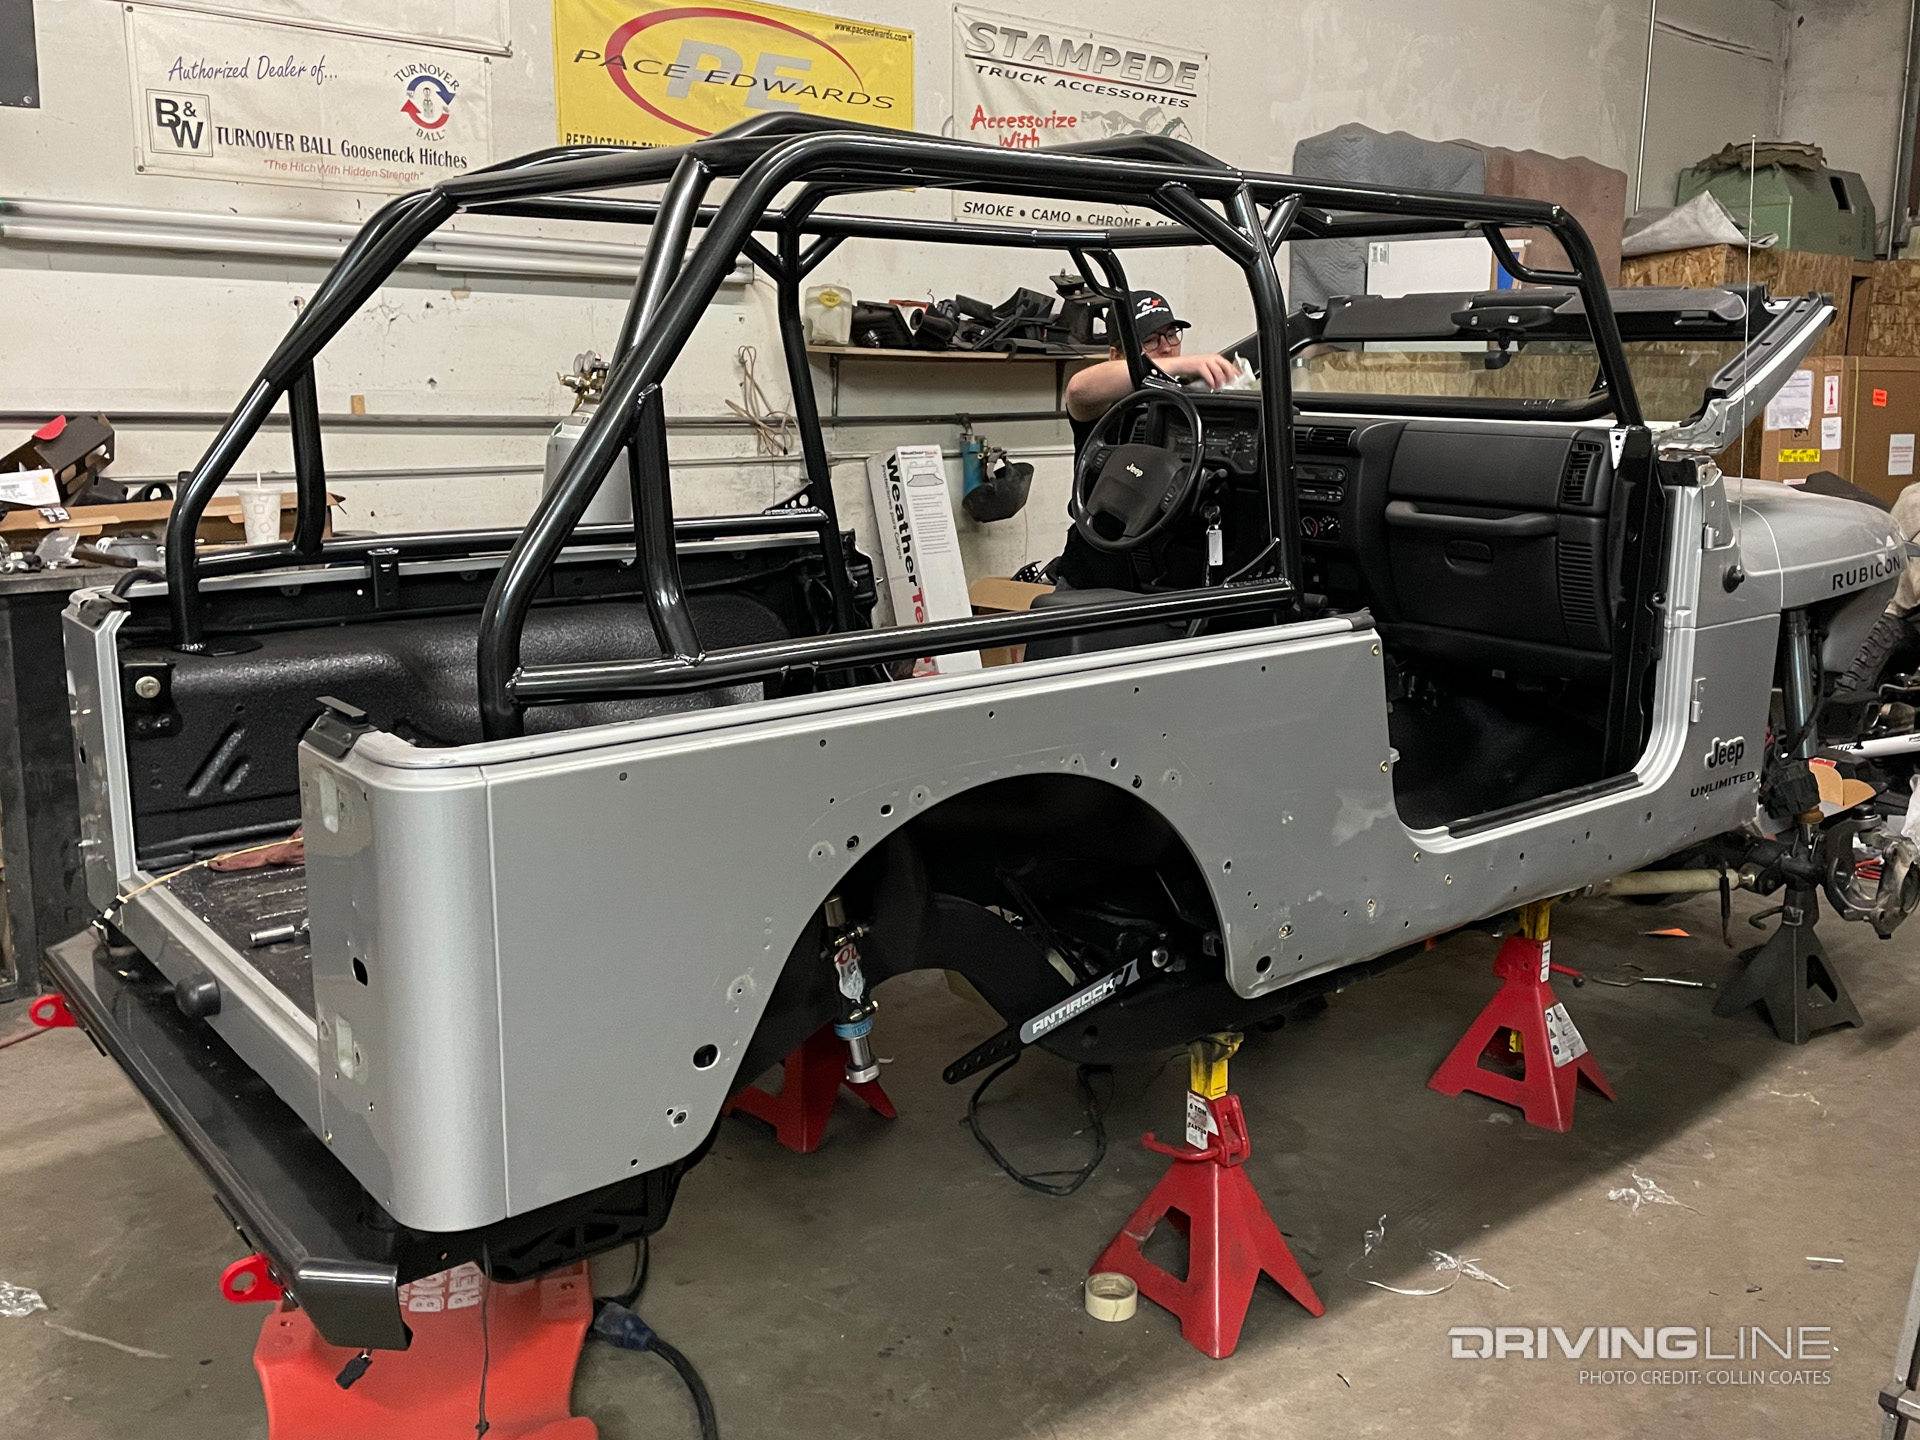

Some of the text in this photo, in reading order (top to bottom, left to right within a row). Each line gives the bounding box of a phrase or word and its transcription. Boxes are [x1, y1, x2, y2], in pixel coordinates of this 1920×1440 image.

[834, 23, 908, 42] www.paceedwards.com
[168, 56, 251, 81] Authorized
[256, 55, 306, 80] Dealer
[964, 21, 1200, 90] STAMPEDE
[393, 62, 460, 91] TURNOVER
[573, 49, 895, 109] PACE EDWARDS
[975, 64, 1190, 109] TRUCK ACCESSORIES
[970, 104, 1078, 130] Accessorize
[215, 126, 468, 169] TURNOVER BALL Gooseneck Hitches
[289, 161, 316, 173] Hitch
[317, 164, 341, 175] With
[343, 165, 378, 178] Hidden
[963, 201, 1142, 229] SMOKE CAMO CHROME
[886, 453, 925, 624] WeatherTe
[1831, 557, 1901, 591] RUBICON
[1705, 736, 1746, 770] Jeep
[1690, 770, 1756, 798] UNLIMITED
[1032, 978, 1116, 1034] ANTIROCK
